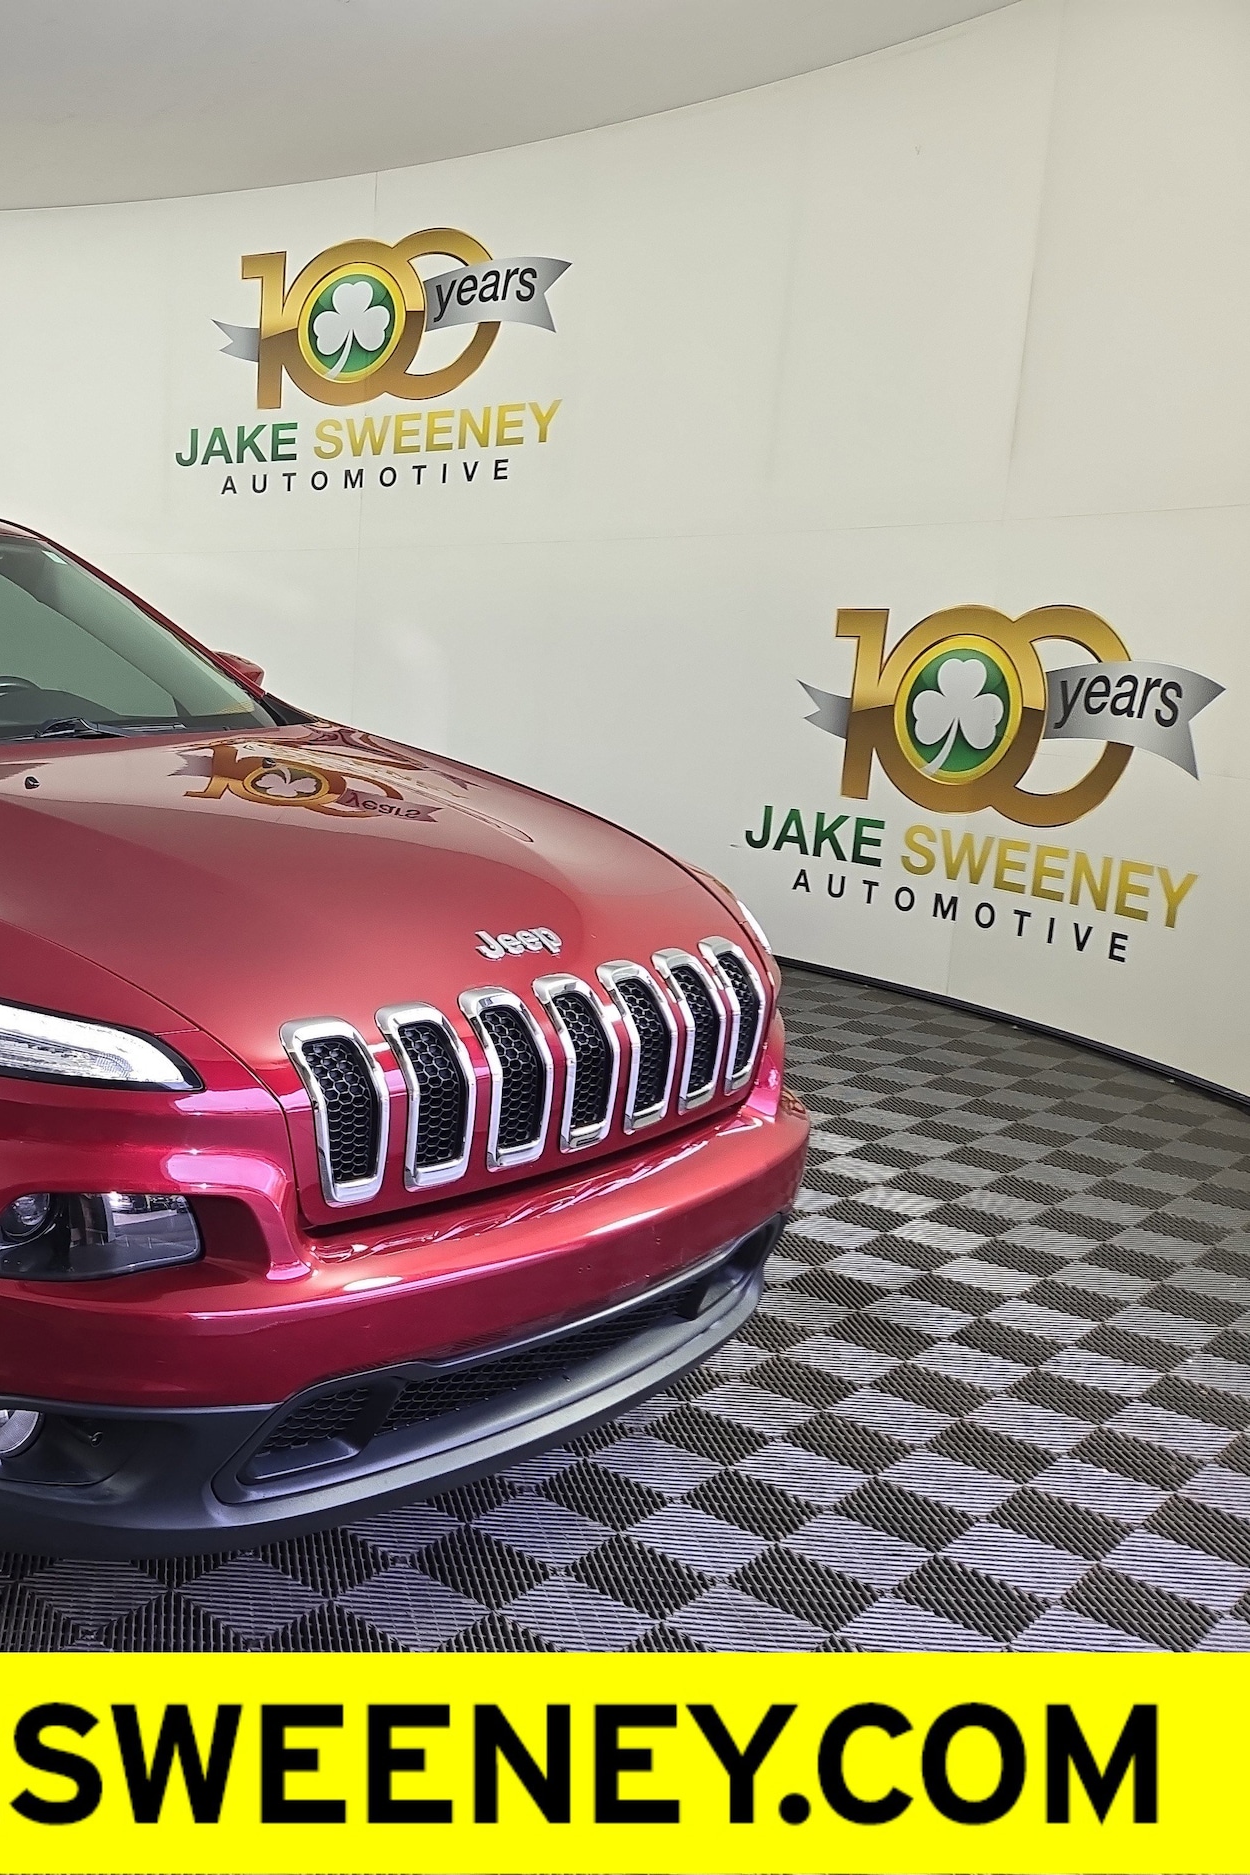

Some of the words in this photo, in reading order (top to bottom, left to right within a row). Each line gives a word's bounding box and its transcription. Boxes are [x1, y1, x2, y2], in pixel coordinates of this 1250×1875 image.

[241, 227, 503, 410] 100
[433, 267, 538, 323] years
[175, 422, 298, 467] JAKE
[313, 399, 563, 460] SWEENEY
[221, 459, 510, 496] AUTOMOTIVE
[835, 603, 1136, 829] 100
[1052, 672, 1184, 729] years
[745, 805, 886, 867] JAKE
[900, 824, 1199, 929] SWEENEY
[474, 926, 563, 961] Jeep
[792, 868, 1130, 964] AUTOMOTIVE
